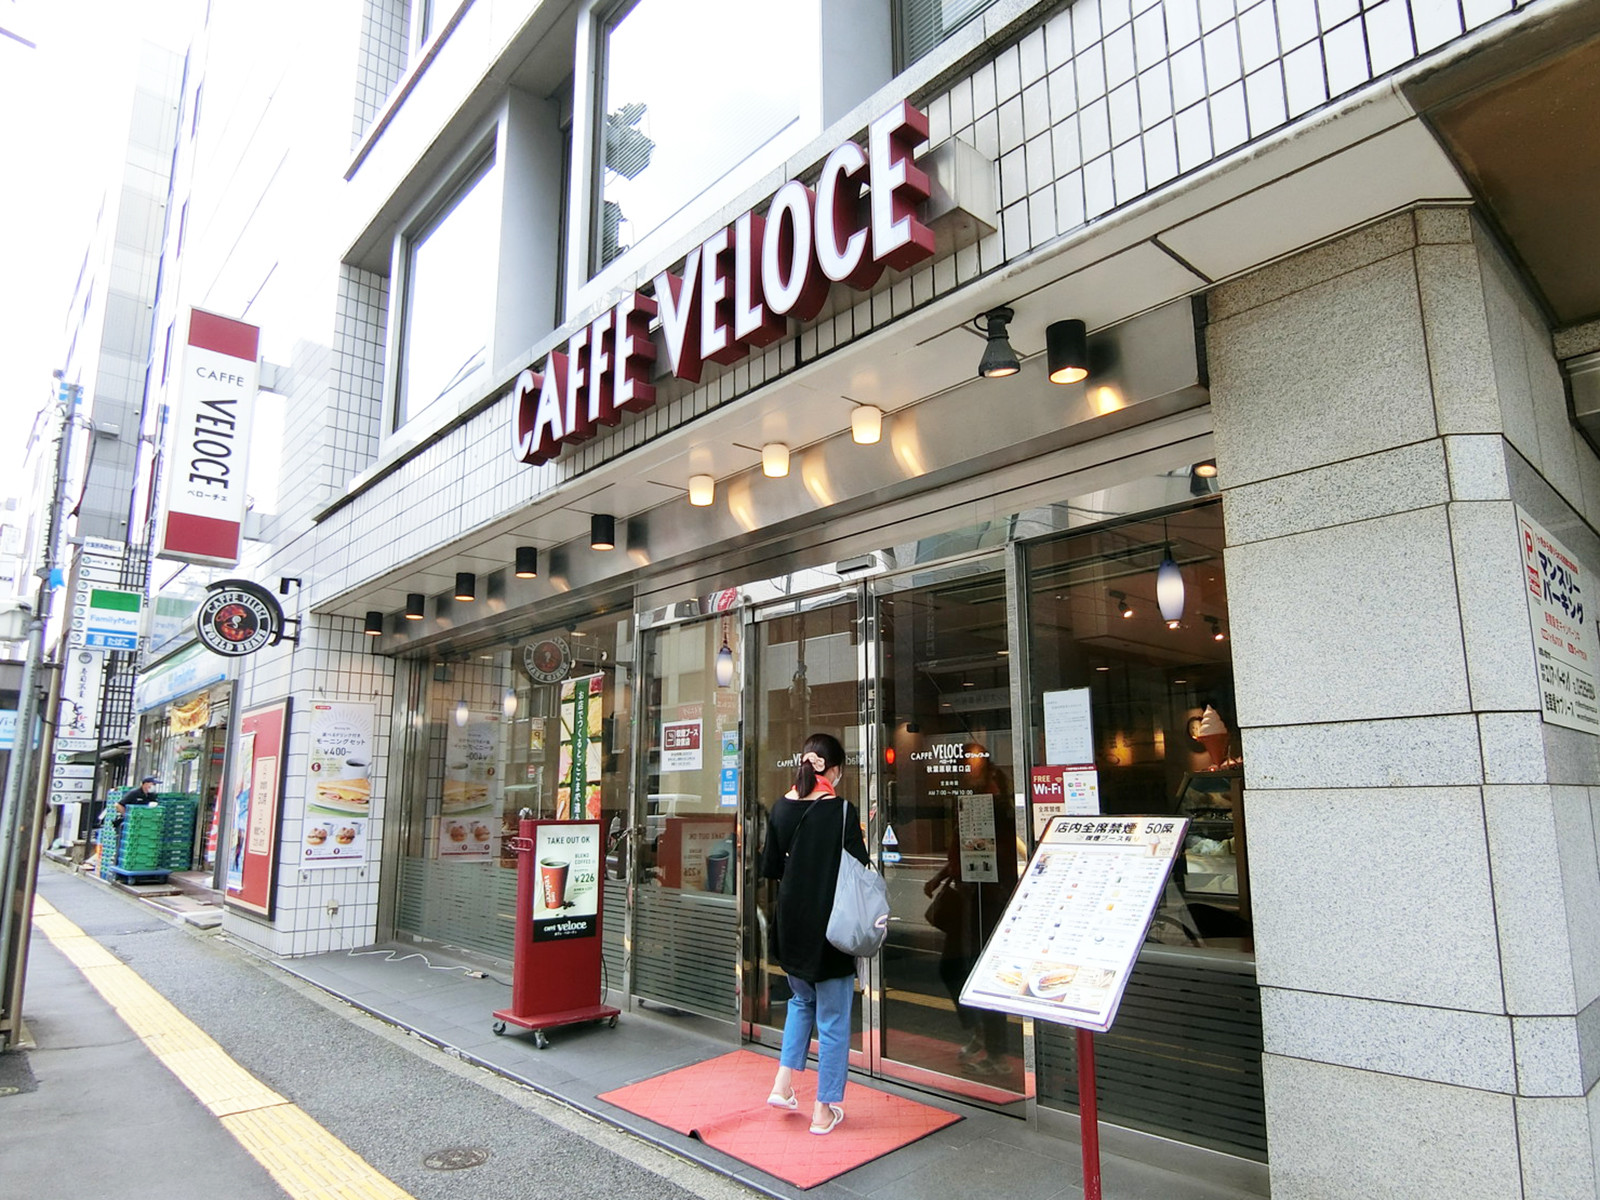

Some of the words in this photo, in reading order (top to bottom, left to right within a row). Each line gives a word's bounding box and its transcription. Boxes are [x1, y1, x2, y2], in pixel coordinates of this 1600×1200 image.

[511, 291, 646, 465] CAFFE
[654, 100, 920, 380] VELOCE
[196, 366, 244, 388] CAFFE
[189, 399, 237, 490] VELOCE
[187, 489, 228, 502] ベローチェ
[1538, 550, 1581, 594] マンスリー
[207, 593, 239, 613] CAFFE
[1543, 579, 1583, 625] パーキング
[90, 614, 137, 626] FamilyMart
[203, 623, 233, 651] WORLD
[910, 751, 933, 761] CAFFE
[932, 743, 964, 759] VELOCE
[776, 760, 794, 768] CAFFE
[1033, 775, 1051, 783] FREE
[1033, 783, 1061, 795] Wi-Fi
[1054, 822, 1138, 835] 店内全席禁煙
[1145, 822, 1175, 835] 50席
[547, 837, 564, 845] TAKE
[566, 836, 580, 844] OUT
[557, 920, 588, 932] veloce
